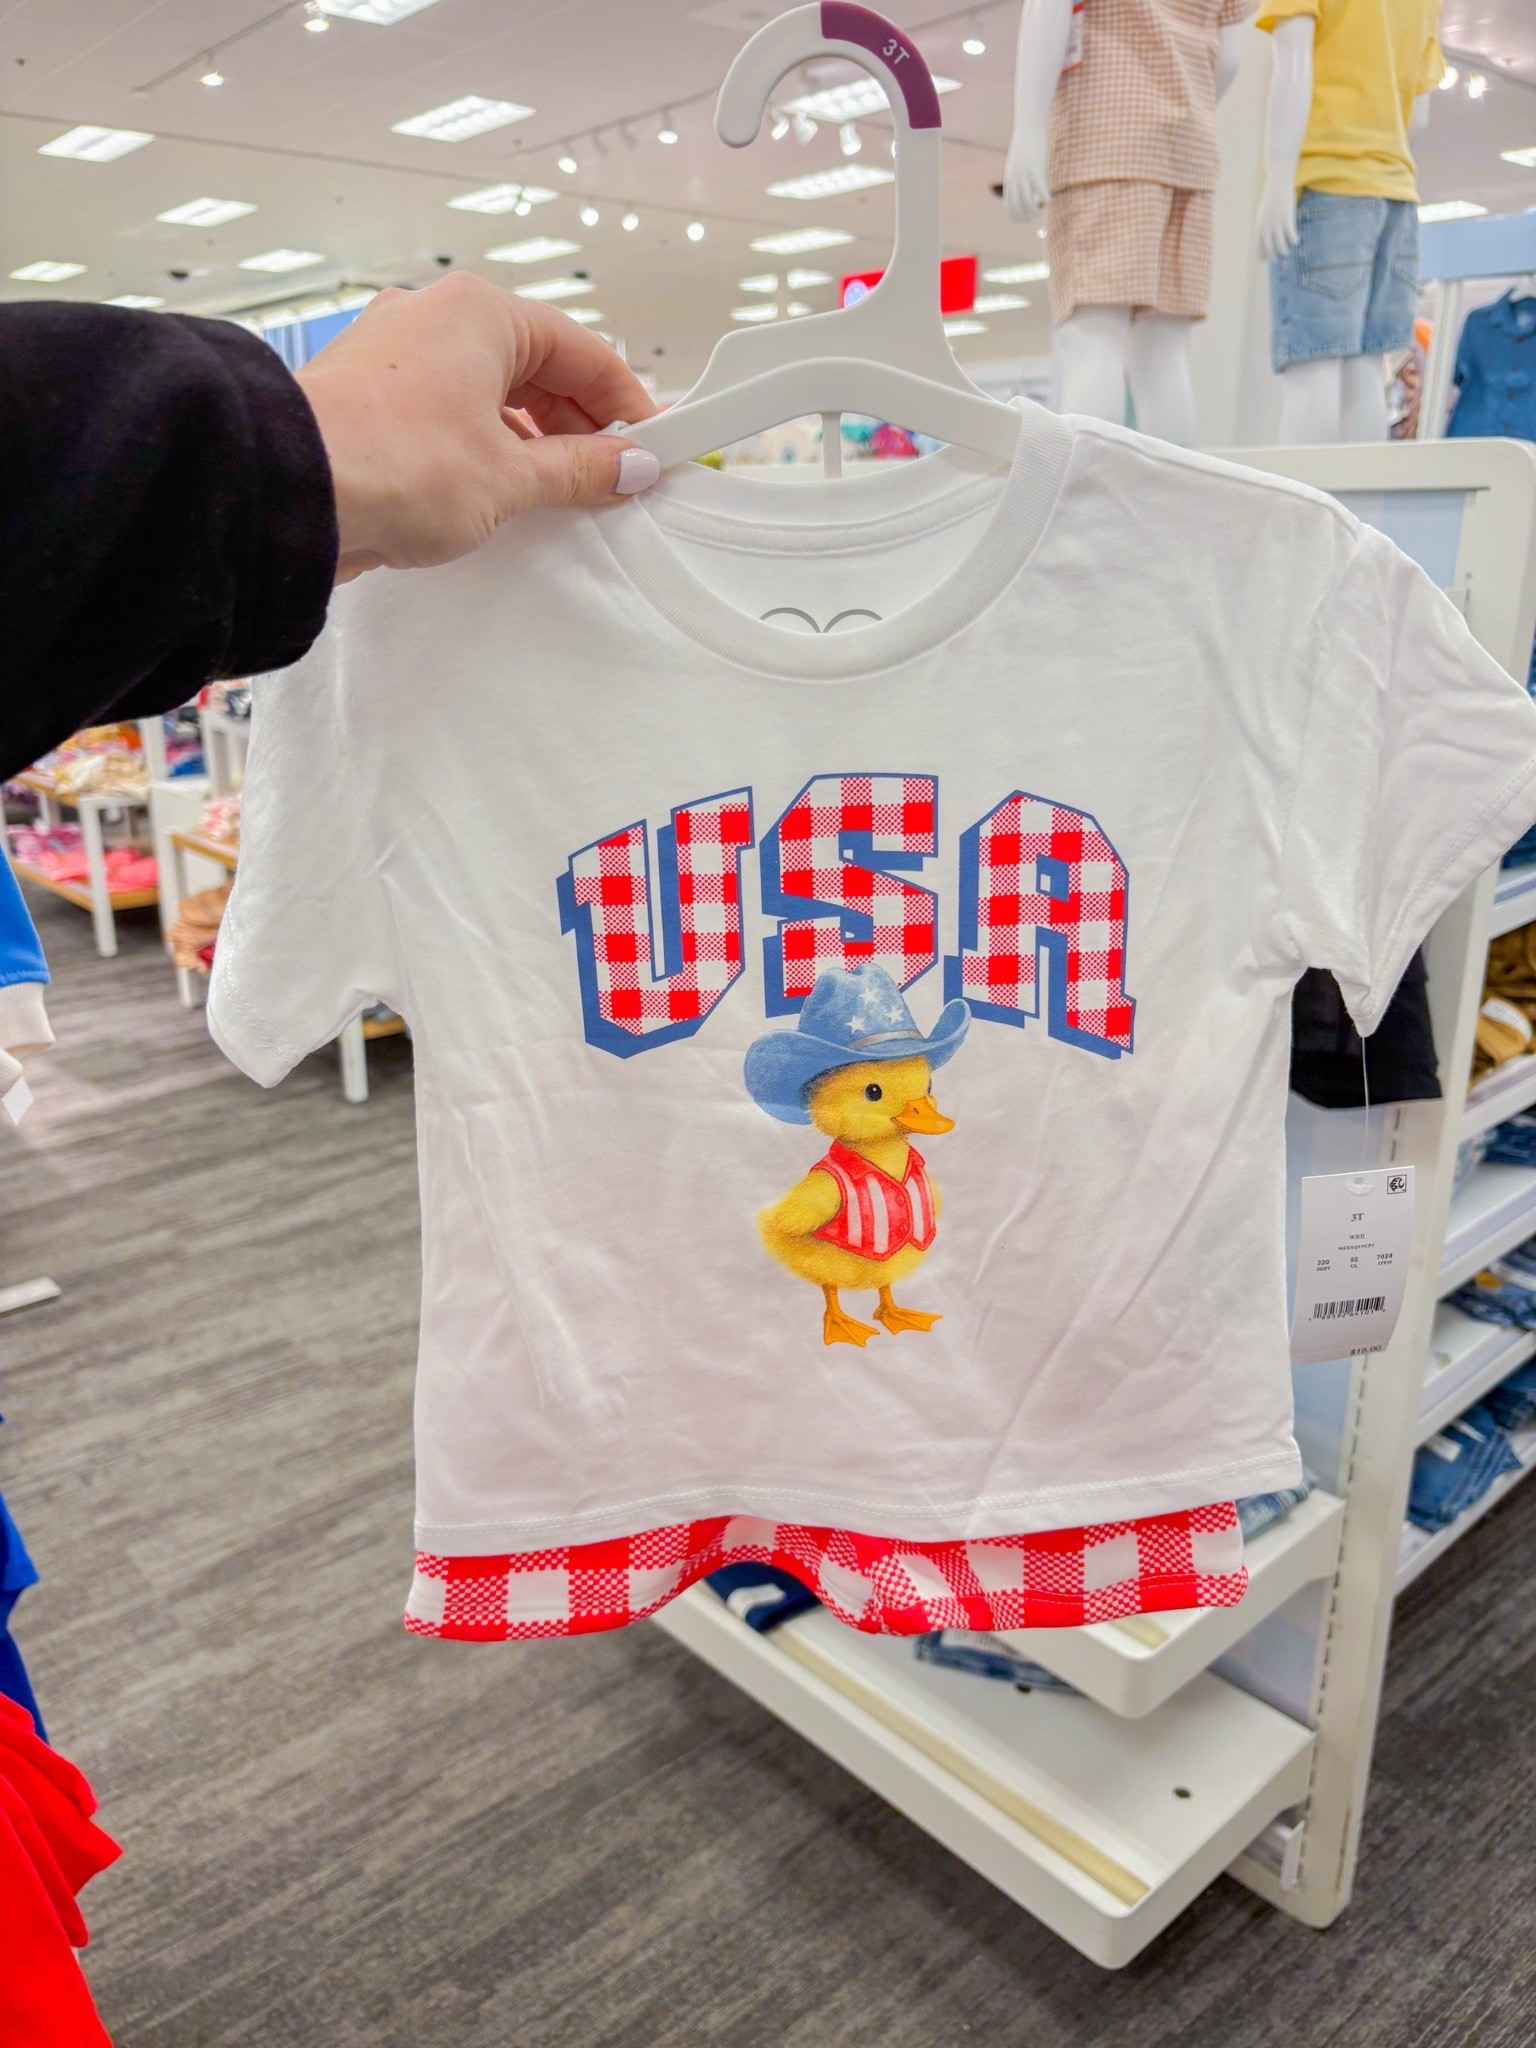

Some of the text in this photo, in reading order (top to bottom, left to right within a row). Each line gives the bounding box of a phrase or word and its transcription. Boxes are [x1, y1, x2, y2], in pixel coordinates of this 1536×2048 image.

[883, 38, 910, 64] 3T
[556, 772, 1136, 1059] USA
[1350, 1212, 1365, 1222] 3T
